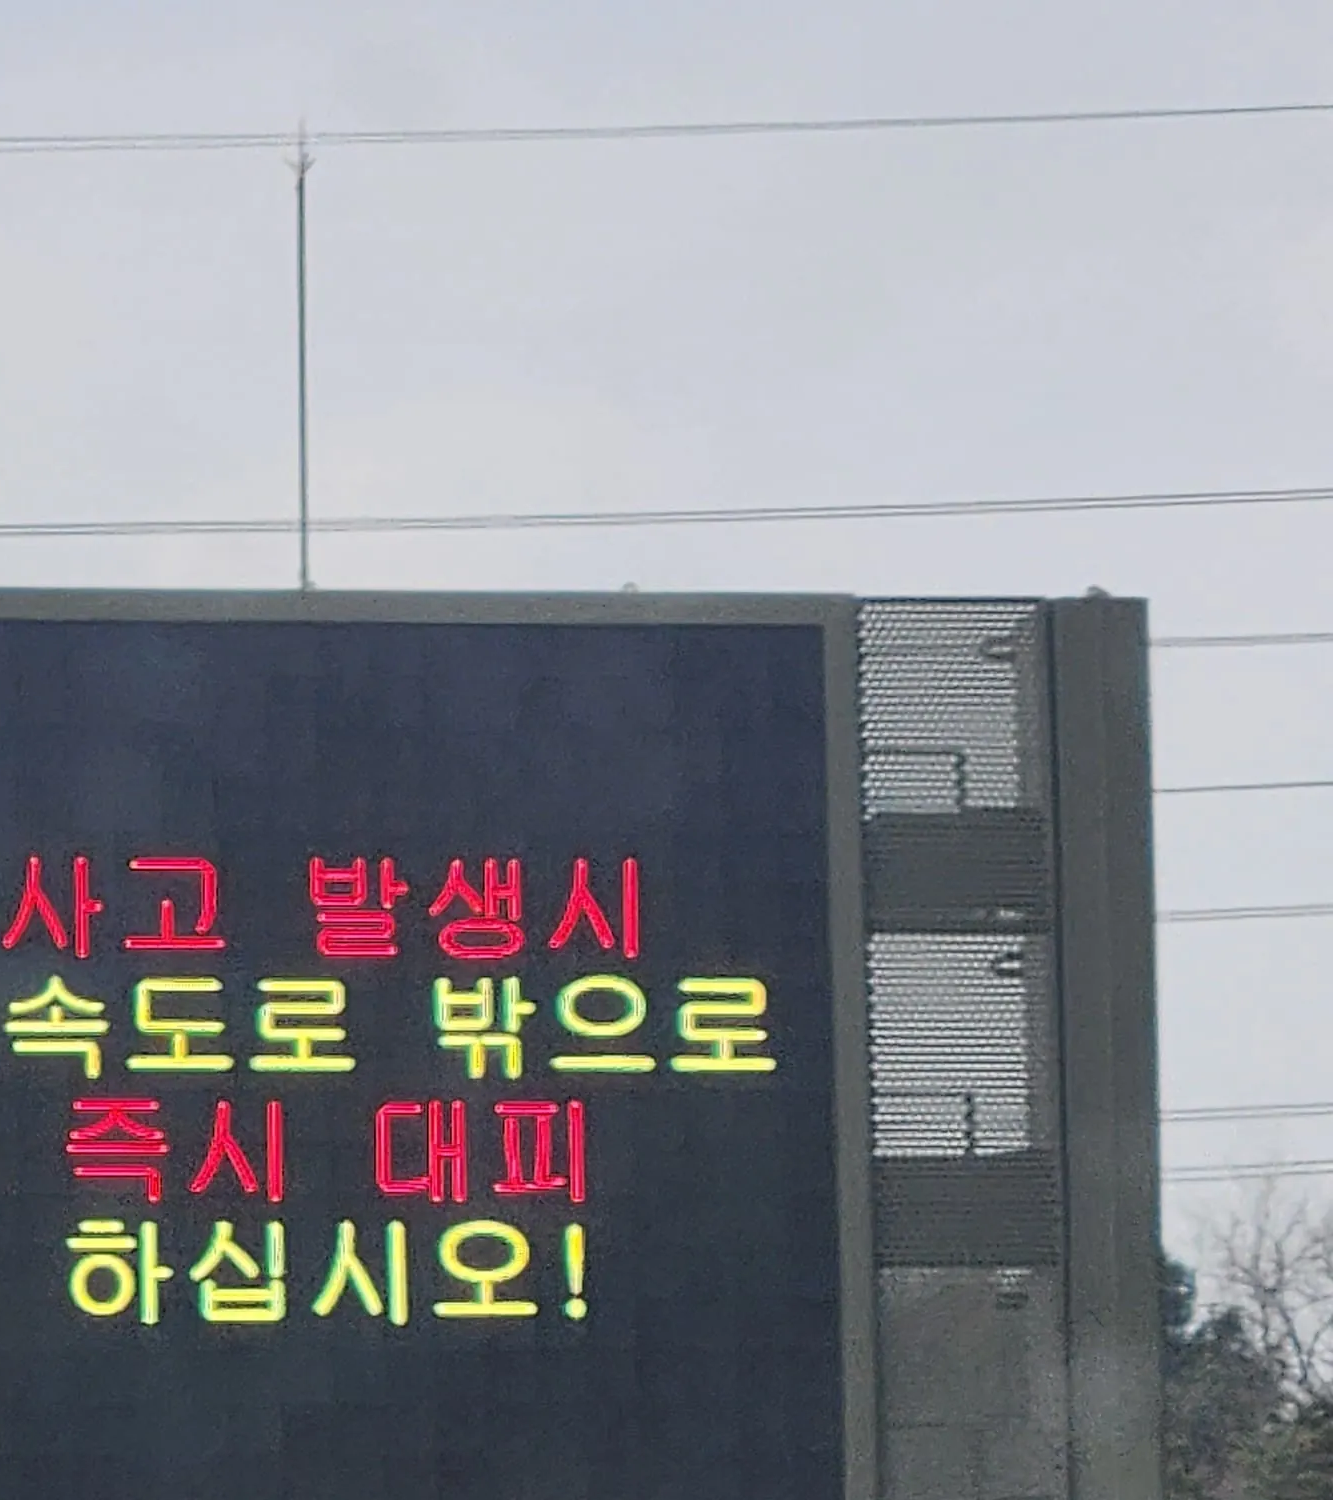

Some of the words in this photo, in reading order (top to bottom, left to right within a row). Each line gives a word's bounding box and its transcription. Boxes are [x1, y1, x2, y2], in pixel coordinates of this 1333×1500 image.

[2, 856, 226, 959] 사고
[309, 856, 640, 960] 발생시
[433, 974, 778, 1080] 밖으로
[65, 1097, 285, 1204] 즉시
[375, 1099, 587, 1204] 대피
[66, 1219, 588, 1327] 하십시오!
